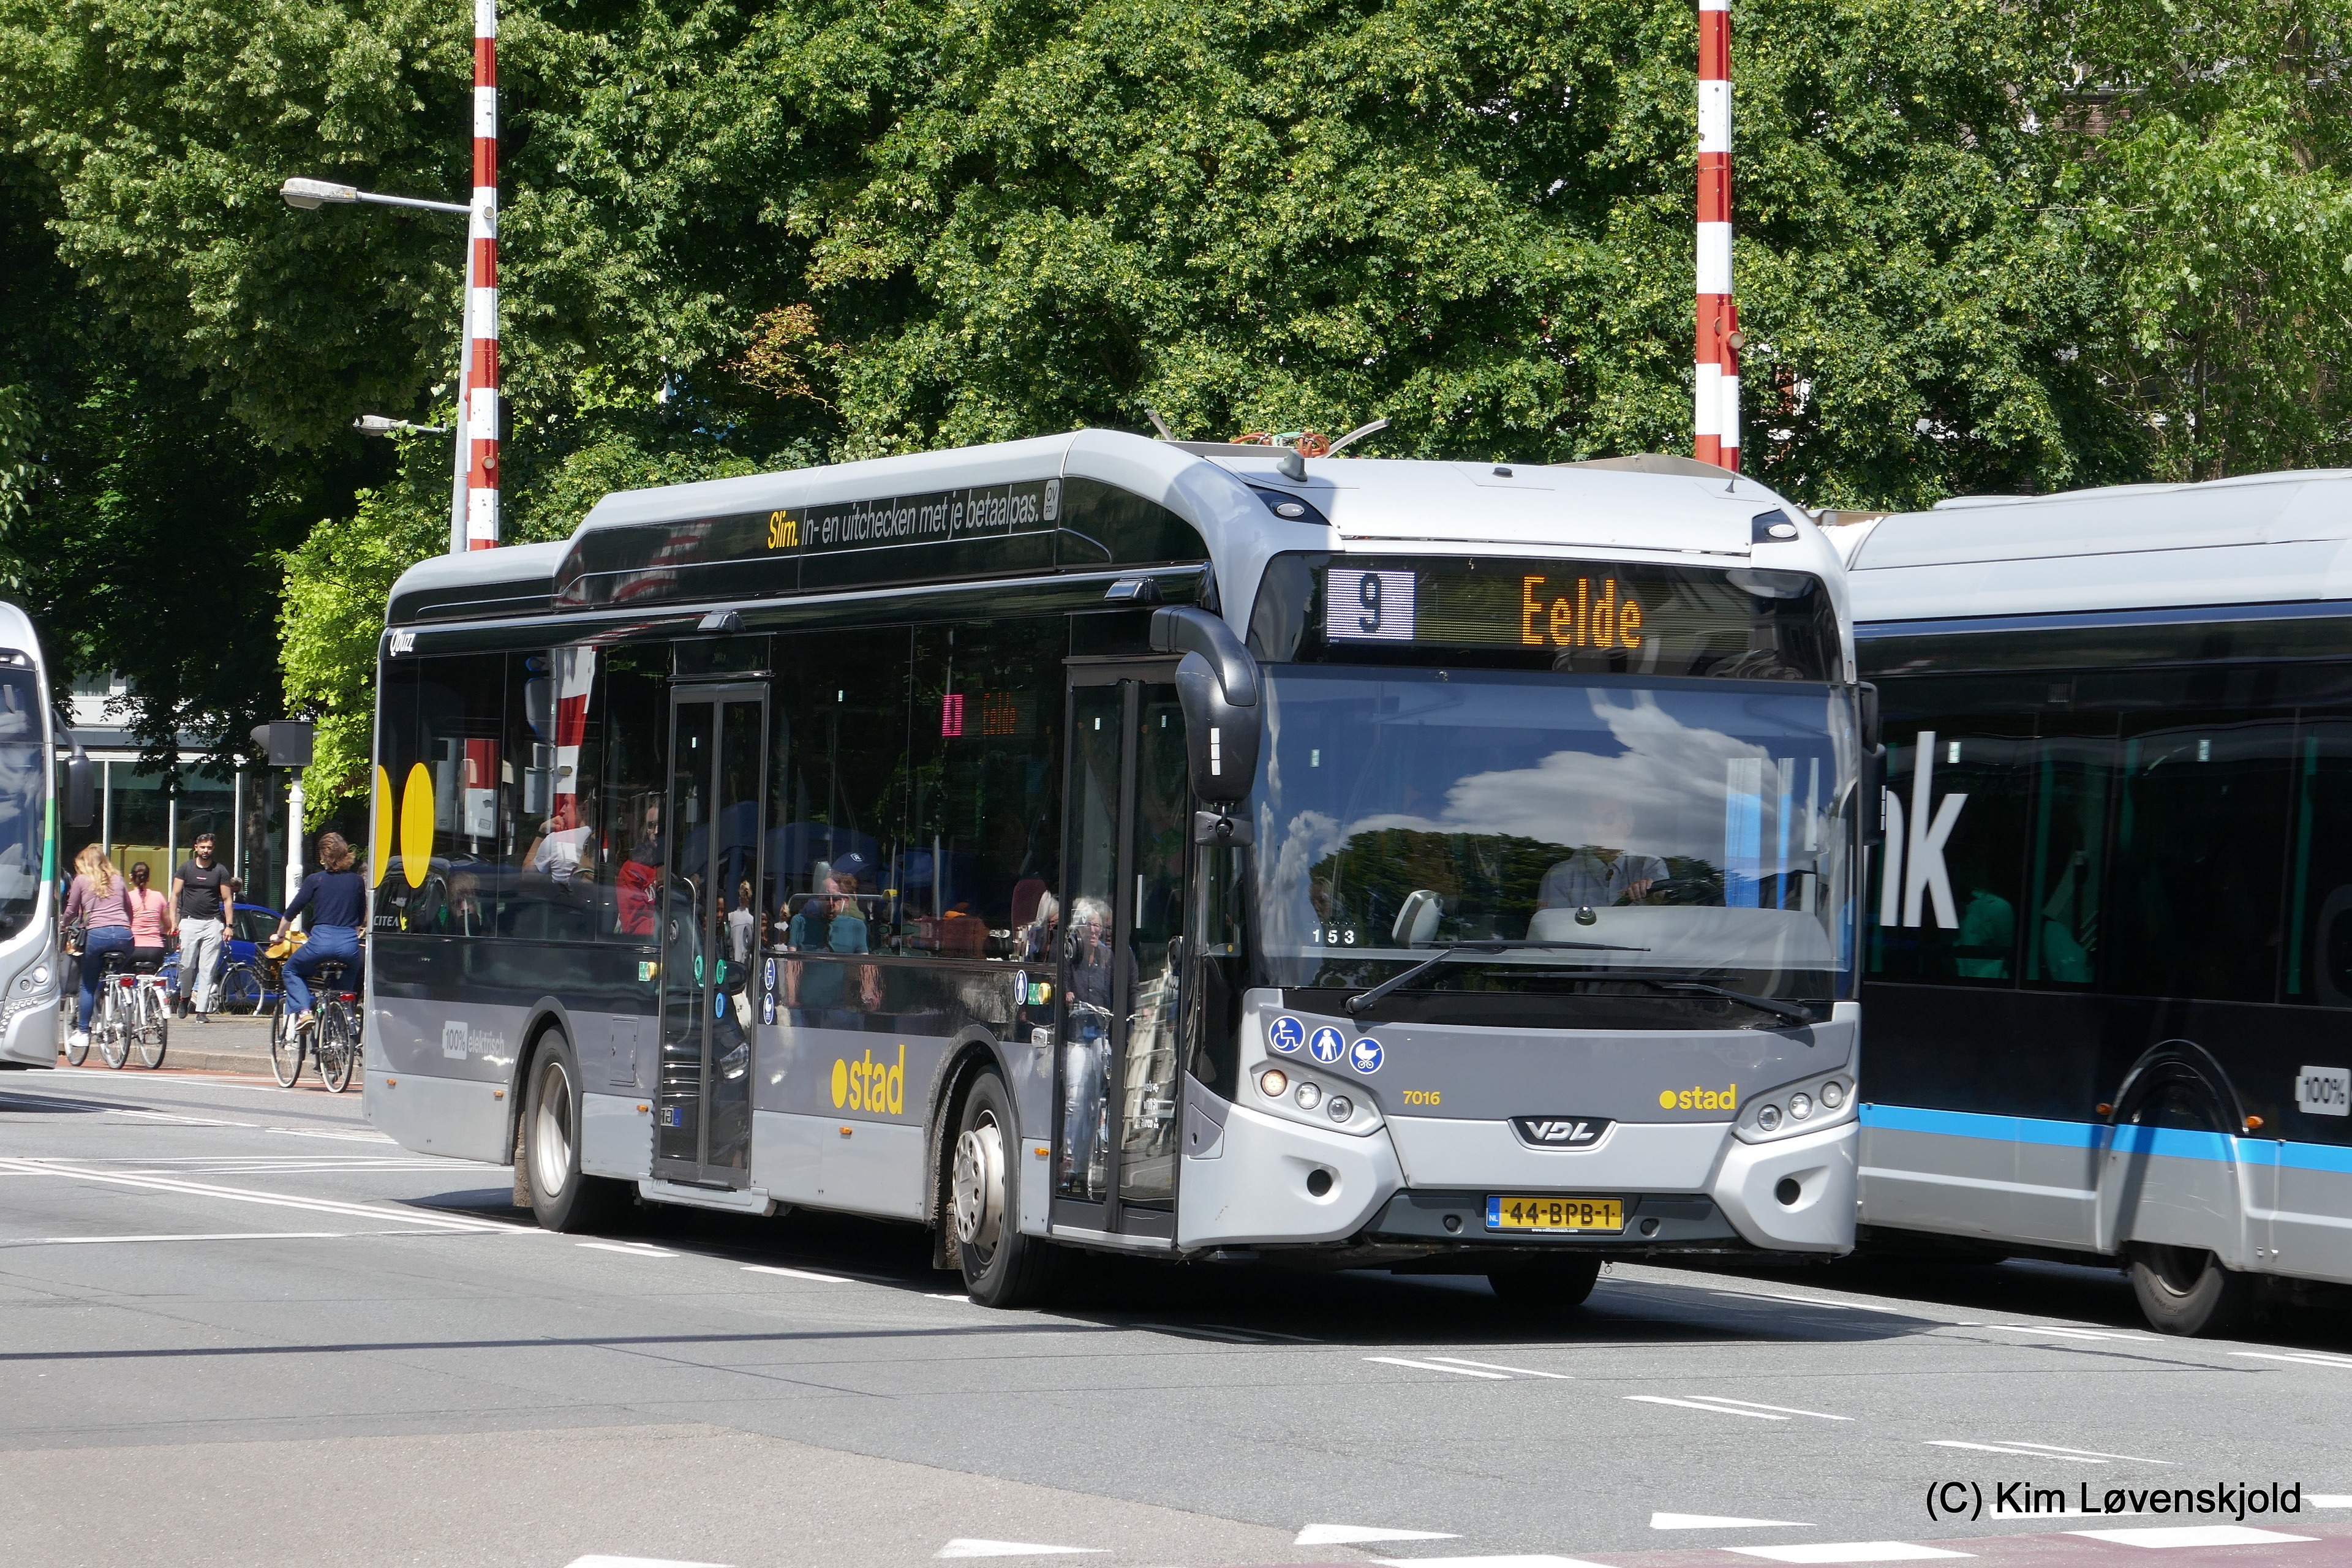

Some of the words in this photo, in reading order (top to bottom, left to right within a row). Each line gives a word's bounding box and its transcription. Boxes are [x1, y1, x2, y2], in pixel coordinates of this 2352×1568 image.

[1046, 486, 1058, 502] OV
[767, 510, 797, 549] Slim.
[822, 516, 839, 544] en
[842, 497, 916, 542] uitchecken
[919, 497, 948, 533] met
[948, 491, 963, 540] je
[965, 484, 1039, 534] betaalpas.
[1359, 572, 1382, 634] 9
[1522, 576, 1642, 649] Eelde
[390, 629, 416, 657] Qbuzz
[374, 915, 399, 927] CITEA
[446, 1029, 466, 1052] 100%
[467, 1030, 504, 1056] elektrisch
[849, 1044, 905, 1115] stad
[2304, 1077, 2345, 1106] 100%
[1403, 1091, 1441, 1106] 7016
[1679, 1084, 1736, 1110] stad
[1525, 1121, 1594, 1141] VDL
[1510, 1202, 1610, 1227] 44-BPB-1
